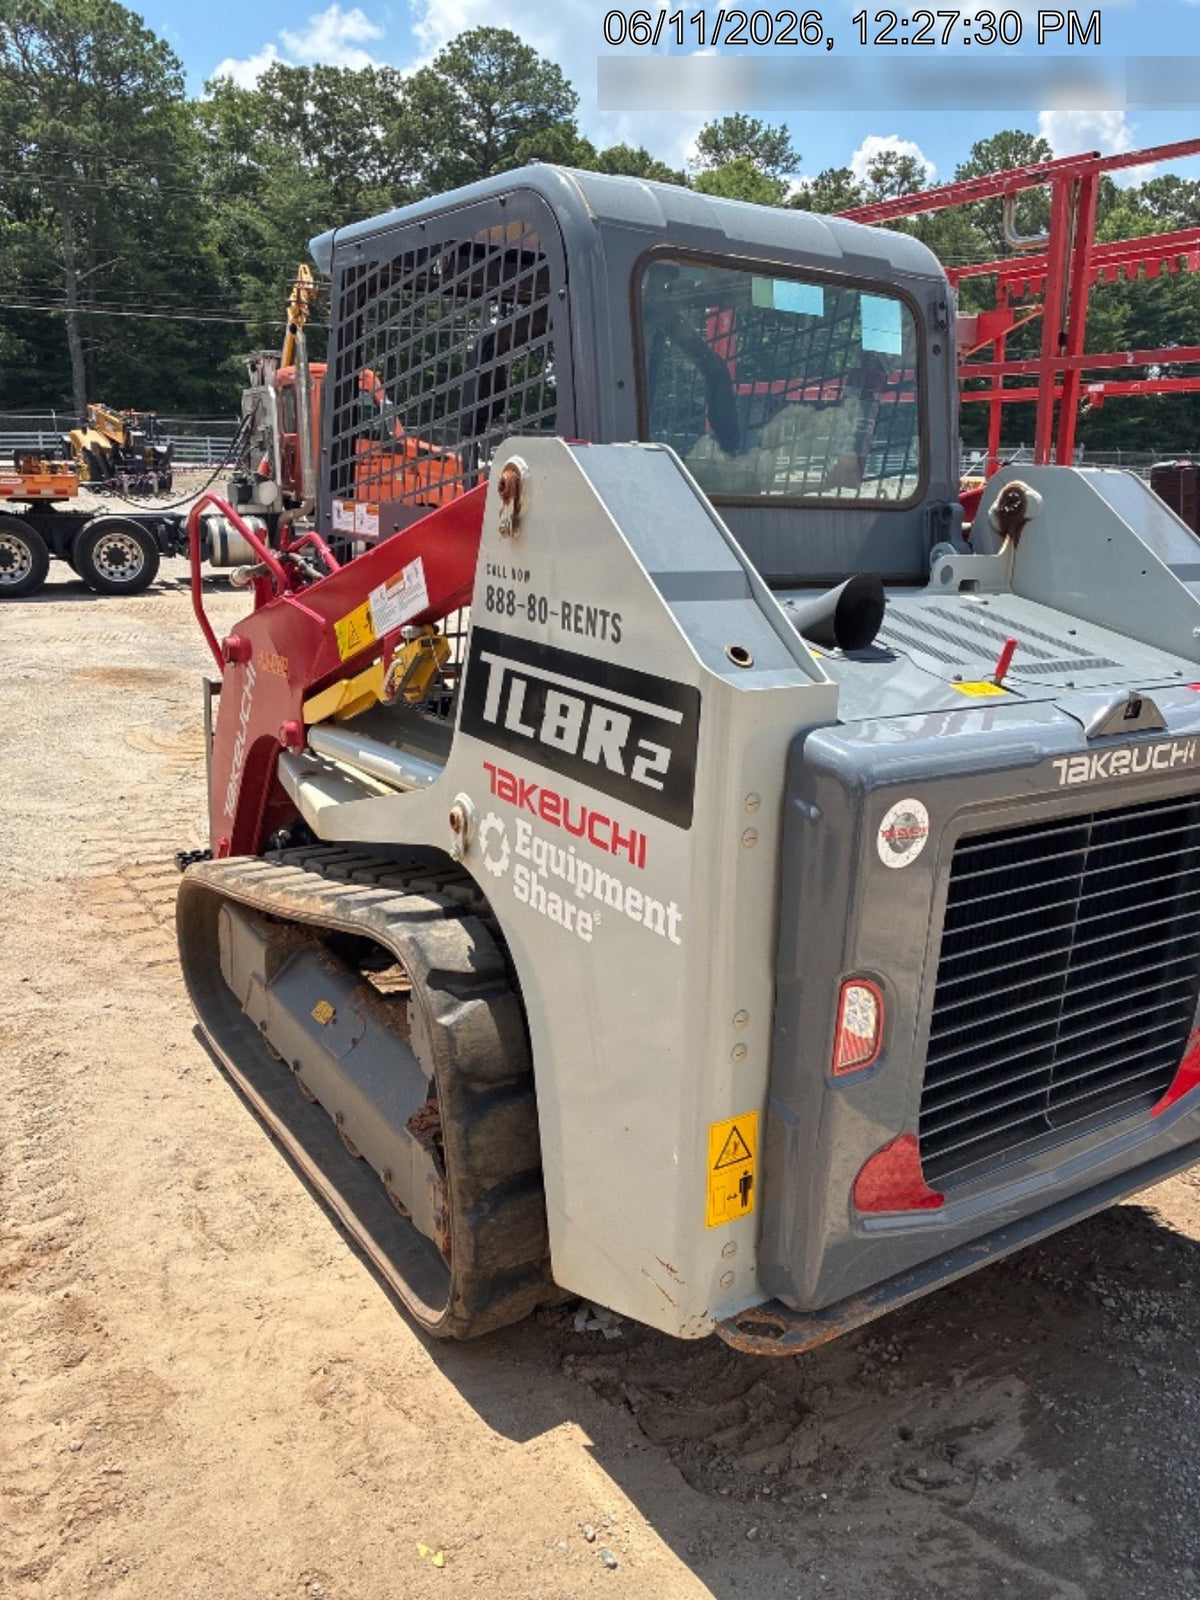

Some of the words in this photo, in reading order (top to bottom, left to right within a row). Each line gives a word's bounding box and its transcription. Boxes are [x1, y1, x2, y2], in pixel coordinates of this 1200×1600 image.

[486, 562, 508, 579] CALL
[511, 567, 531, 583] NOW
[486, 584, 622, 644] 888-80-RENTS
[513, 863, 594, 944] Share
[514, 817, 682, 946] Equipment
